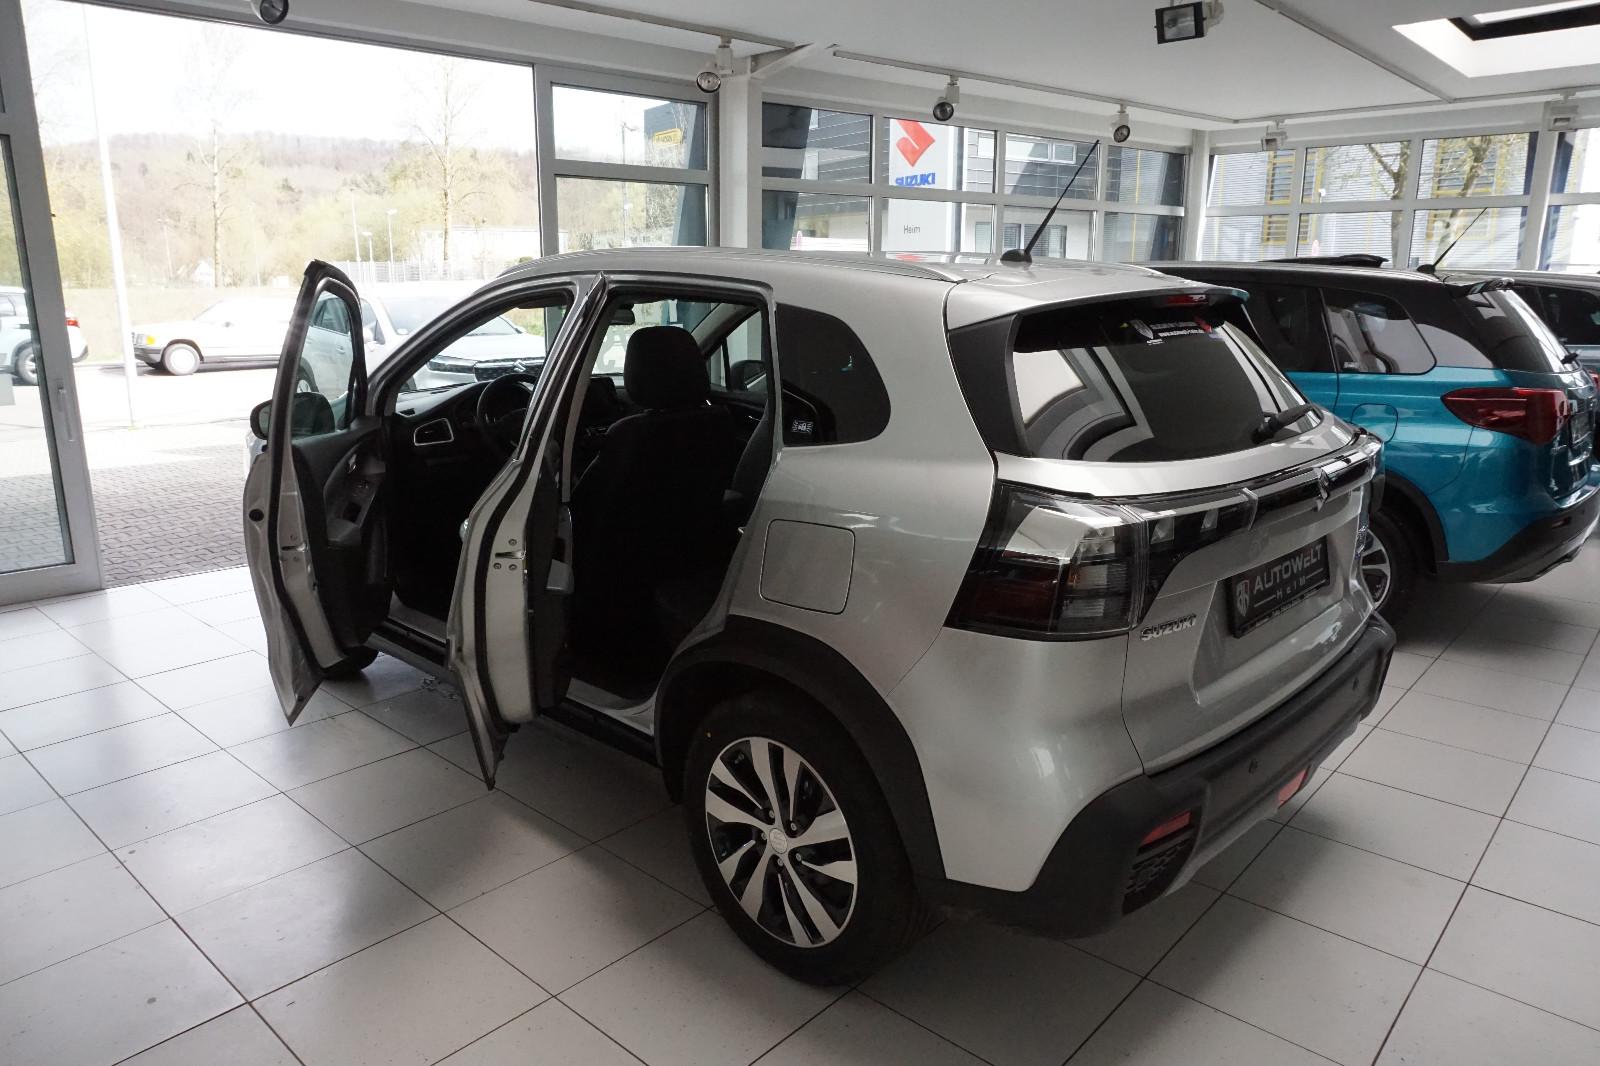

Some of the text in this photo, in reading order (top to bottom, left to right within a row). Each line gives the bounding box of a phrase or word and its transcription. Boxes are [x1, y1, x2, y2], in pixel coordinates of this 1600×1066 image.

[895, 172, 936, 187] SUZUKI
[903, 225, 921, 235] Heim
[1139, 613, 1197, 641] SUZUKI
